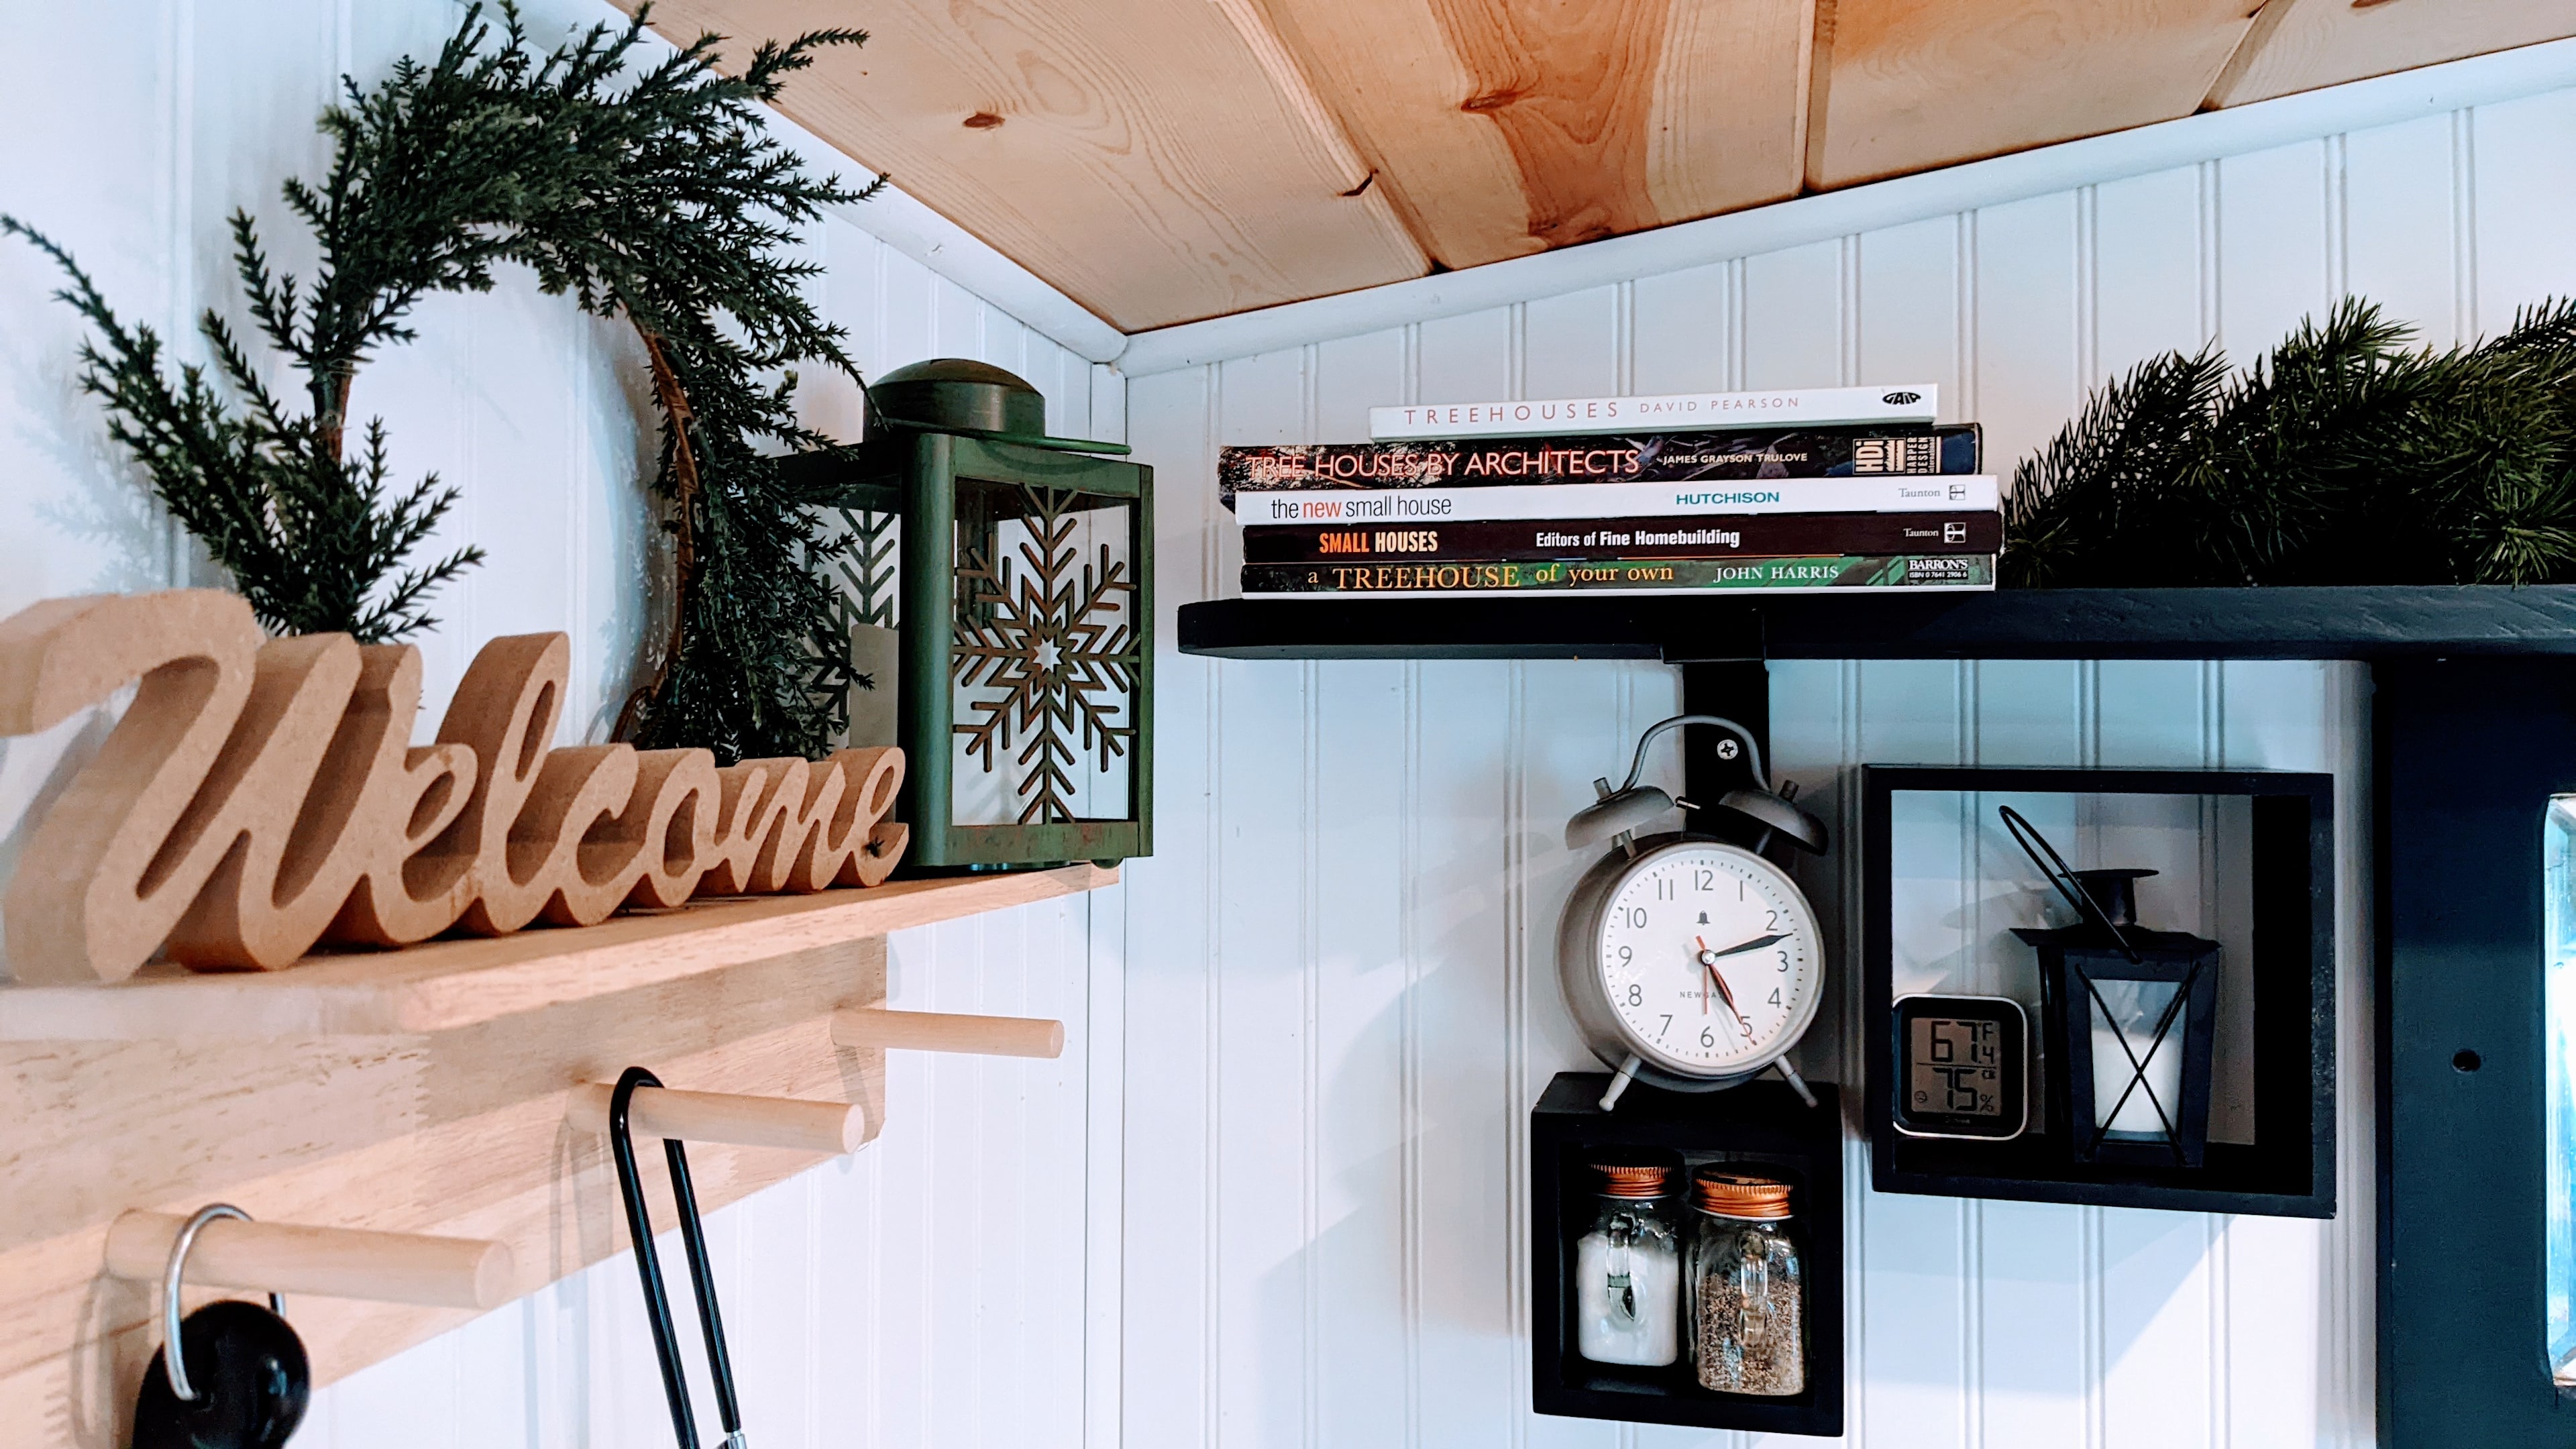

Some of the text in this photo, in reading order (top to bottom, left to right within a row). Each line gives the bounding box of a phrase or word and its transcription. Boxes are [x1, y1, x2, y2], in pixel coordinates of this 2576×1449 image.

[1404, 397, 1799, 425] TREEHOUSES DAVID PEARSON
[1245, 449, 1640, 478] TREE HOUSES BY ARCHITECTS
[1663, 453, 1807, 465] JAMES GRAYSON TRULOVE
[1907, 437, 1917, 474] HARPER
[1918, 437, 1928, 474] DESIGN
[1676, 492, 1780, 504] HUTCHISON
[1898, 488, 1941, 497] Taunton
[1271, 495, 1451, 519] the new small house
[1320, 531, 1438, 553] SMALL HOUSES
[1536, 529, 1740, 547] Editors of Fine Homebuilding
[1903, 528, 1939, 537] Taunton
[1713, 566, 1839, 583] JOHN HARRIS
[1909, 559, 1968, 570] BARRON'S
[1308, 564, 1674, 589] a TREEHOUSE of your own
[0, 589, 910, 985] Welcome
[1658, 879, 1674, 900] 11
[1695, 870, 1713, 892] 12
[1626, 907, 1647, 928] 10
[1765, 910, 1778, 931] 2
[1618, 946, 1633, 967] 9
[1777, 951, 1788, 972] 3
[1628, 984, 1643, 1006] 8
[1767, 987, 1782, 1008] 4
[1659, 1015, 1673, 1036] 7
[1740, 1016, 1752, 1037] 5
[1700, 1026, 1714, 1048] 6
